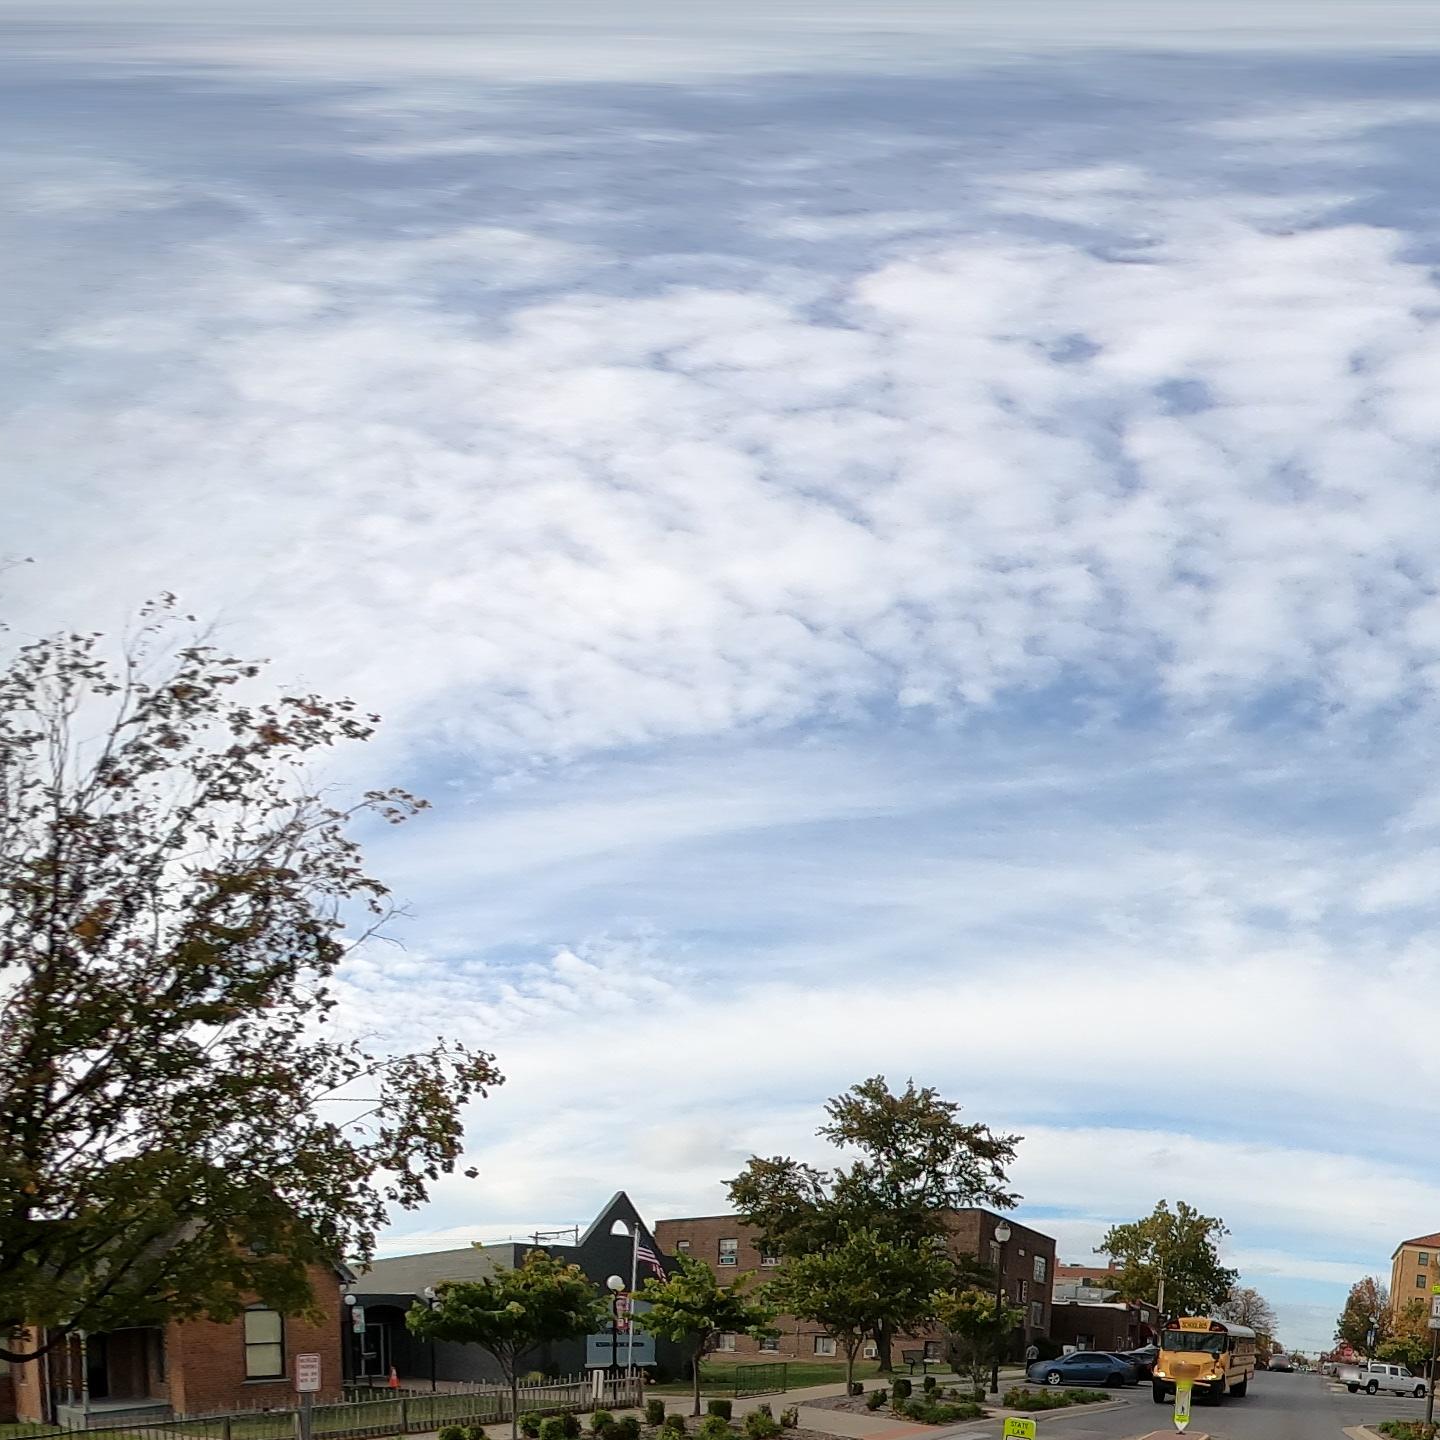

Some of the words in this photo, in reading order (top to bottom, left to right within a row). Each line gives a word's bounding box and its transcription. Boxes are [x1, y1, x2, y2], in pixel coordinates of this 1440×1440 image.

[1182, 1320, 1198, 1329] SCHOOL
[1198, 1320, 1207, 1329] BUS
[1011, 1421, 1028, 1429] STATE
